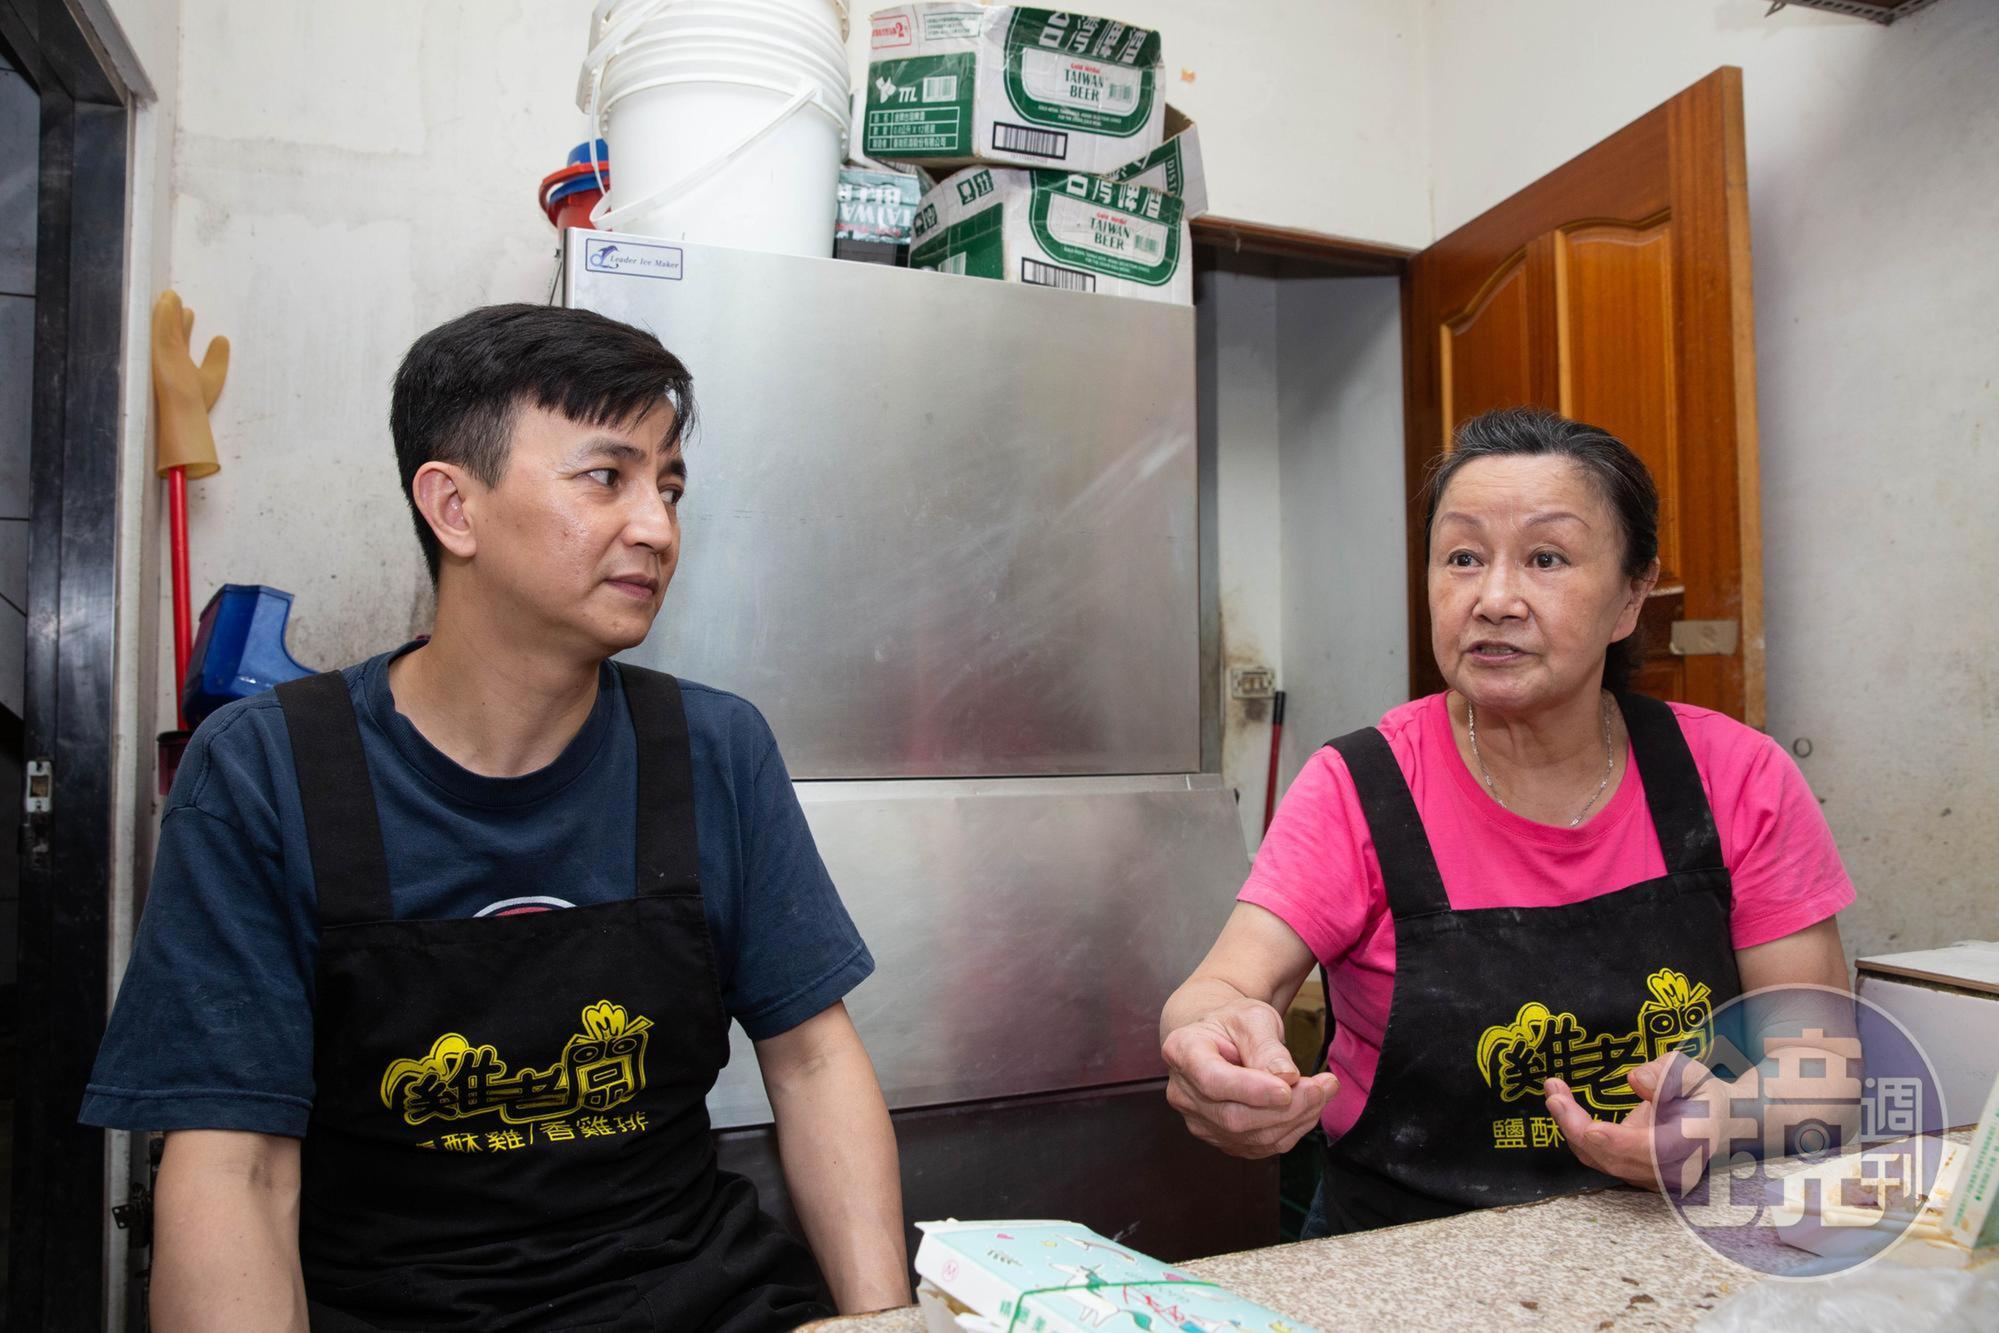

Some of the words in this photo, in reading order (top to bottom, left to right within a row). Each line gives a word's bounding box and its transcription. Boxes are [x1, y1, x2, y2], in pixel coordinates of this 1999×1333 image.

[1064, 69, 1104, 88] TAIWAN
[898, 87, 918, 103] TTL
[1069, 85, 1100, 102] BEER
[840, 202, 911, 227] TAIWA
[1089, 217, 1131, 239] TAIWAN
[1094, 233, 1125, 251] BEER
[610, 255, 637, 264] Leader
[640, 258, 652, 266] Ice
[655, 259, 679, 269] Maker
[416, 1112, 648, 1154] 酥雞/香雞排
